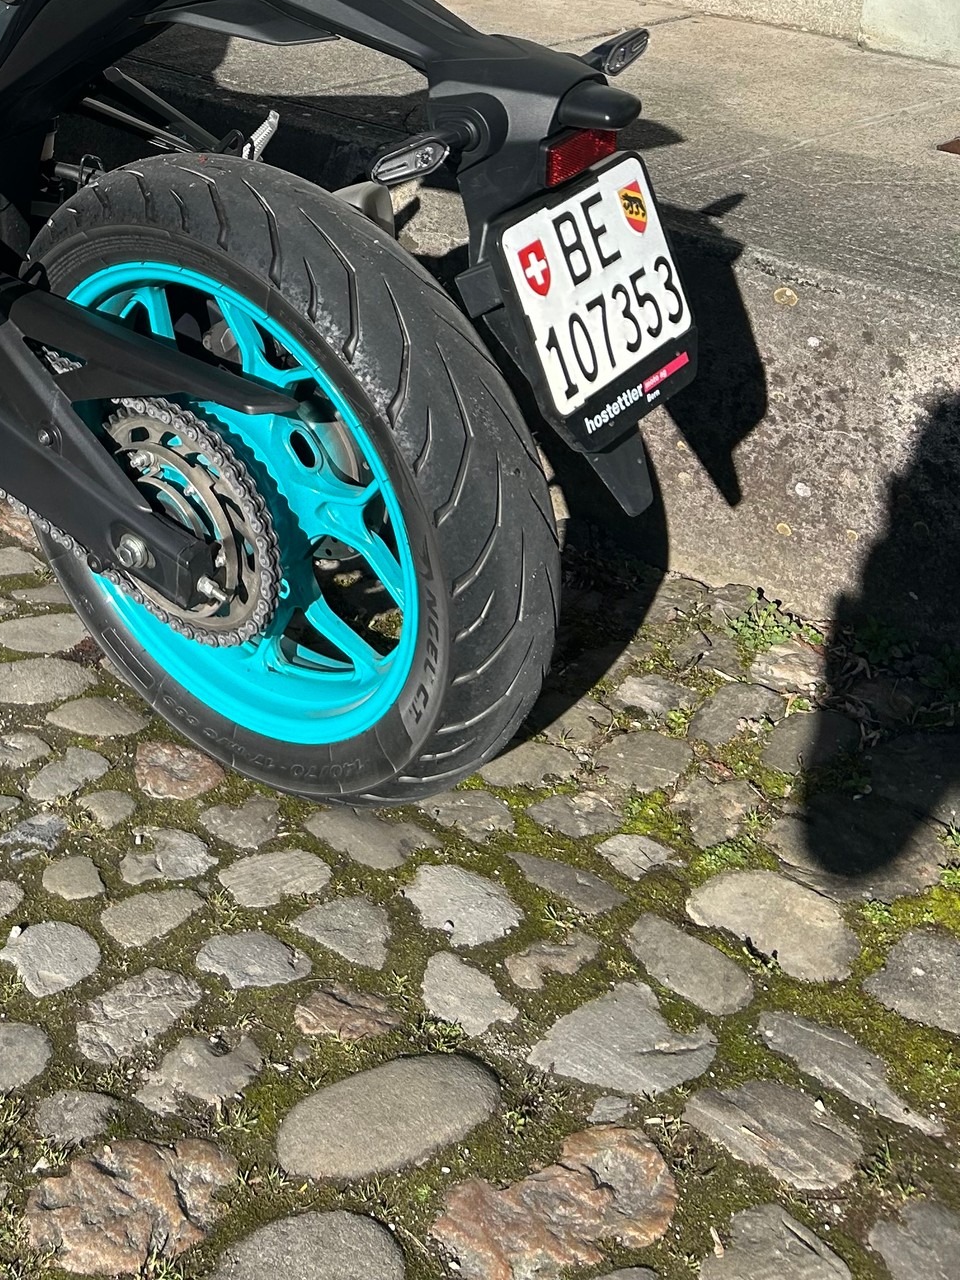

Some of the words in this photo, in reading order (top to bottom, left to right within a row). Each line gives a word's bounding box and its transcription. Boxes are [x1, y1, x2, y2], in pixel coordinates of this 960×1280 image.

[552, 191, 623, 287] BE
[545, 256, 684, 400] 107353
[584, 384, 643, 434] hostettler
